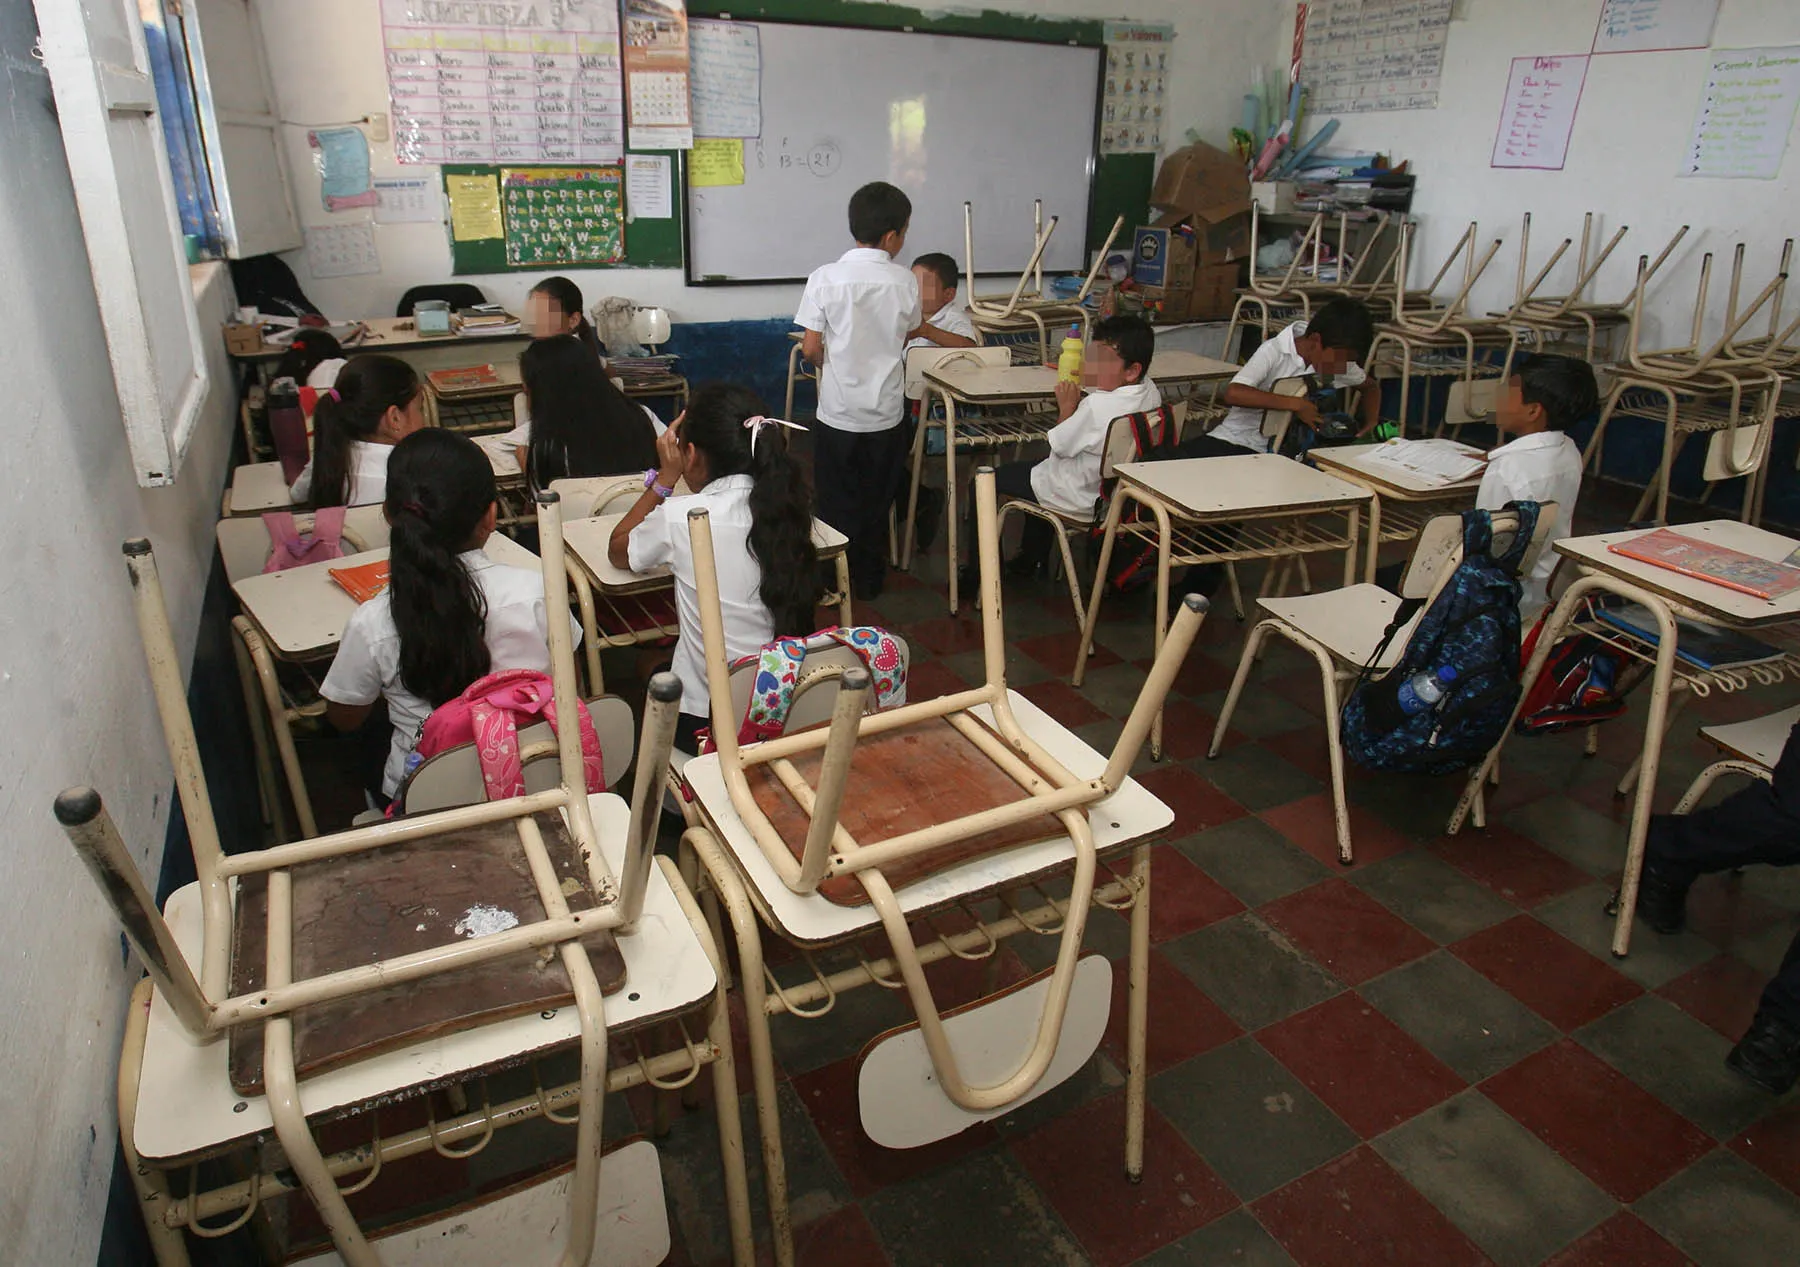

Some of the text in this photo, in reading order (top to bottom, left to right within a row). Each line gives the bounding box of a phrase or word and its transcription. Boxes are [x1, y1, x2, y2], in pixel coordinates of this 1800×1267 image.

[782, 136, 788, 147] F
[780, 154, 793, 169] 13
[813, 152, 831, 168] 21
[509, 189, 518, 200] A
[543, 189, 551, 199] C
[560, 189, 567, 199] D
[575, 189, 583, 199] E
[588, 189, 596, 199] F
[603, 189, 612, 199] G
[507, 204, 517, 214] H
[541, 204, 548, 214] J
[556, 204, 565, 214] K
[576, 204, 583, 214] L
[593, 204, 604, 214] M
[529, 218, 539, 228] O
[564, 218, 572, 228] Q
[584, 218, 593, 228] R
[601, 218, 609, 228] S
[521, 233, 530, 243] T
[541, 232, 551, 242] U
[576, 232, 589, 242] W
[534, 247, 543, 257] X
[591, 245, 600, 255] Z
